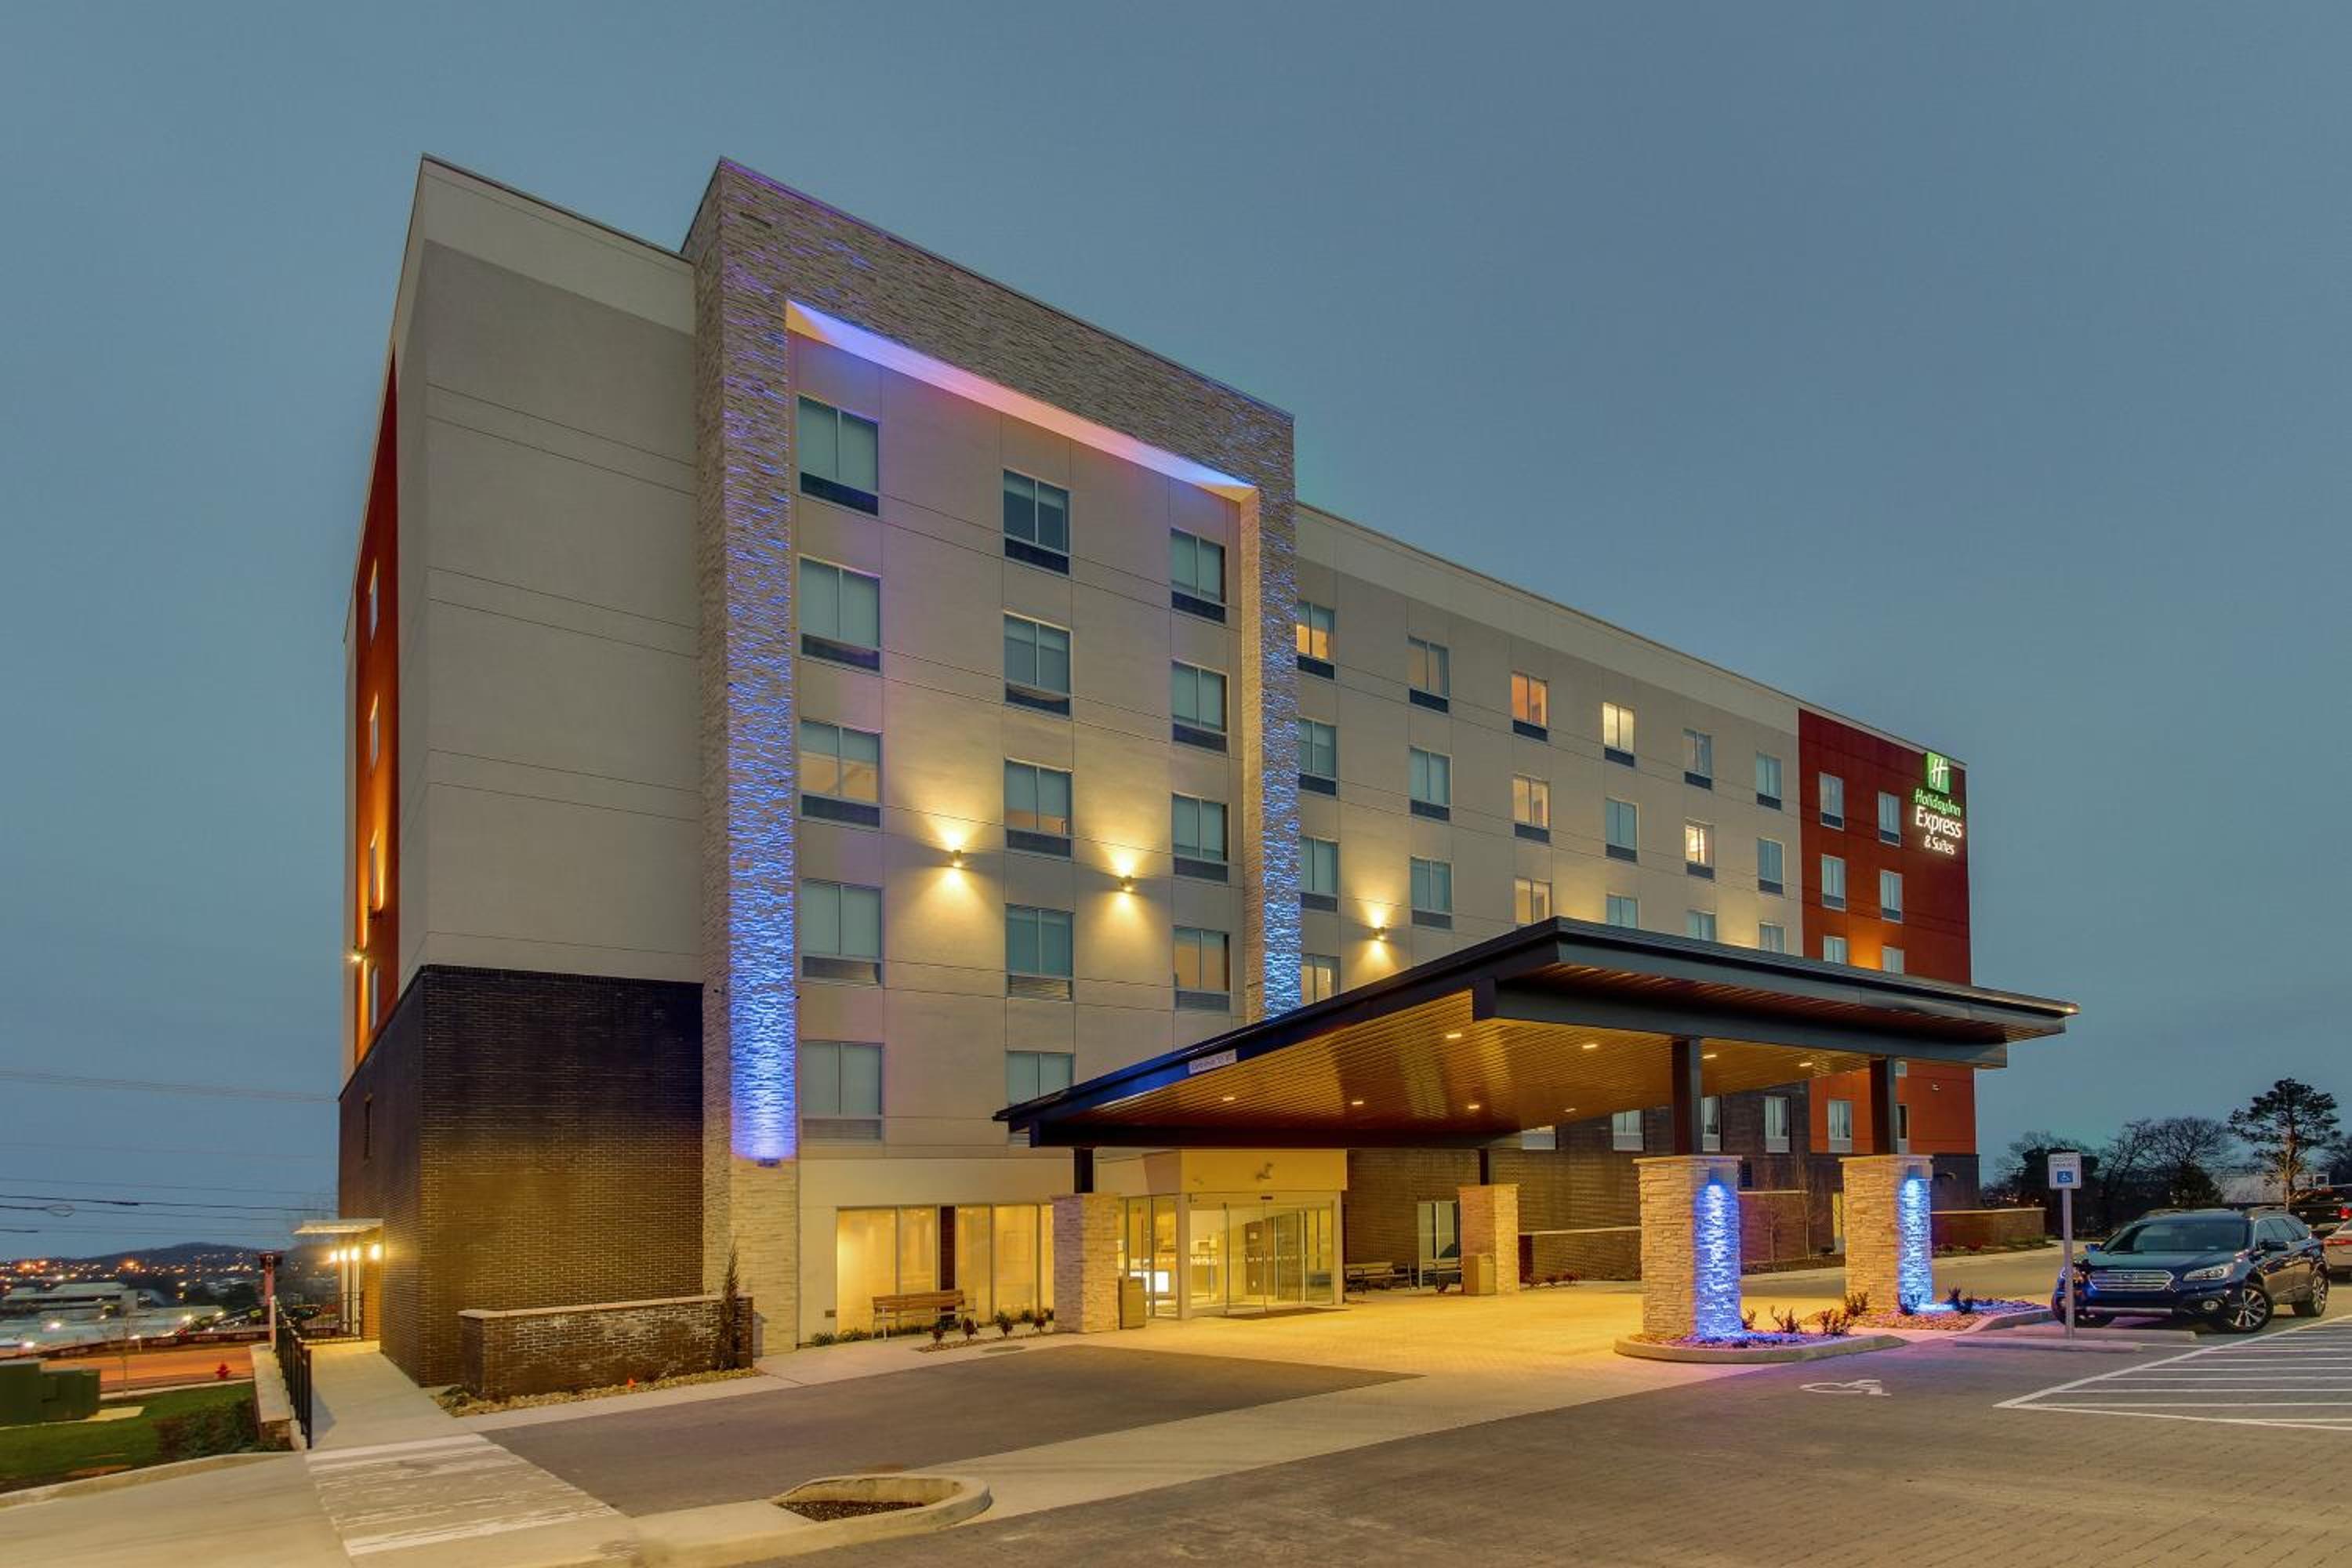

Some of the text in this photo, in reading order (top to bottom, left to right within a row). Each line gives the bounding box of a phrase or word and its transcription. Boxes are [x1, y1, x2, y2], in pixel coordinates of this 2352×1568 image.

[1915, 805, 1962, 838] Express
[1924, 835, 1955, 855] & Suites
